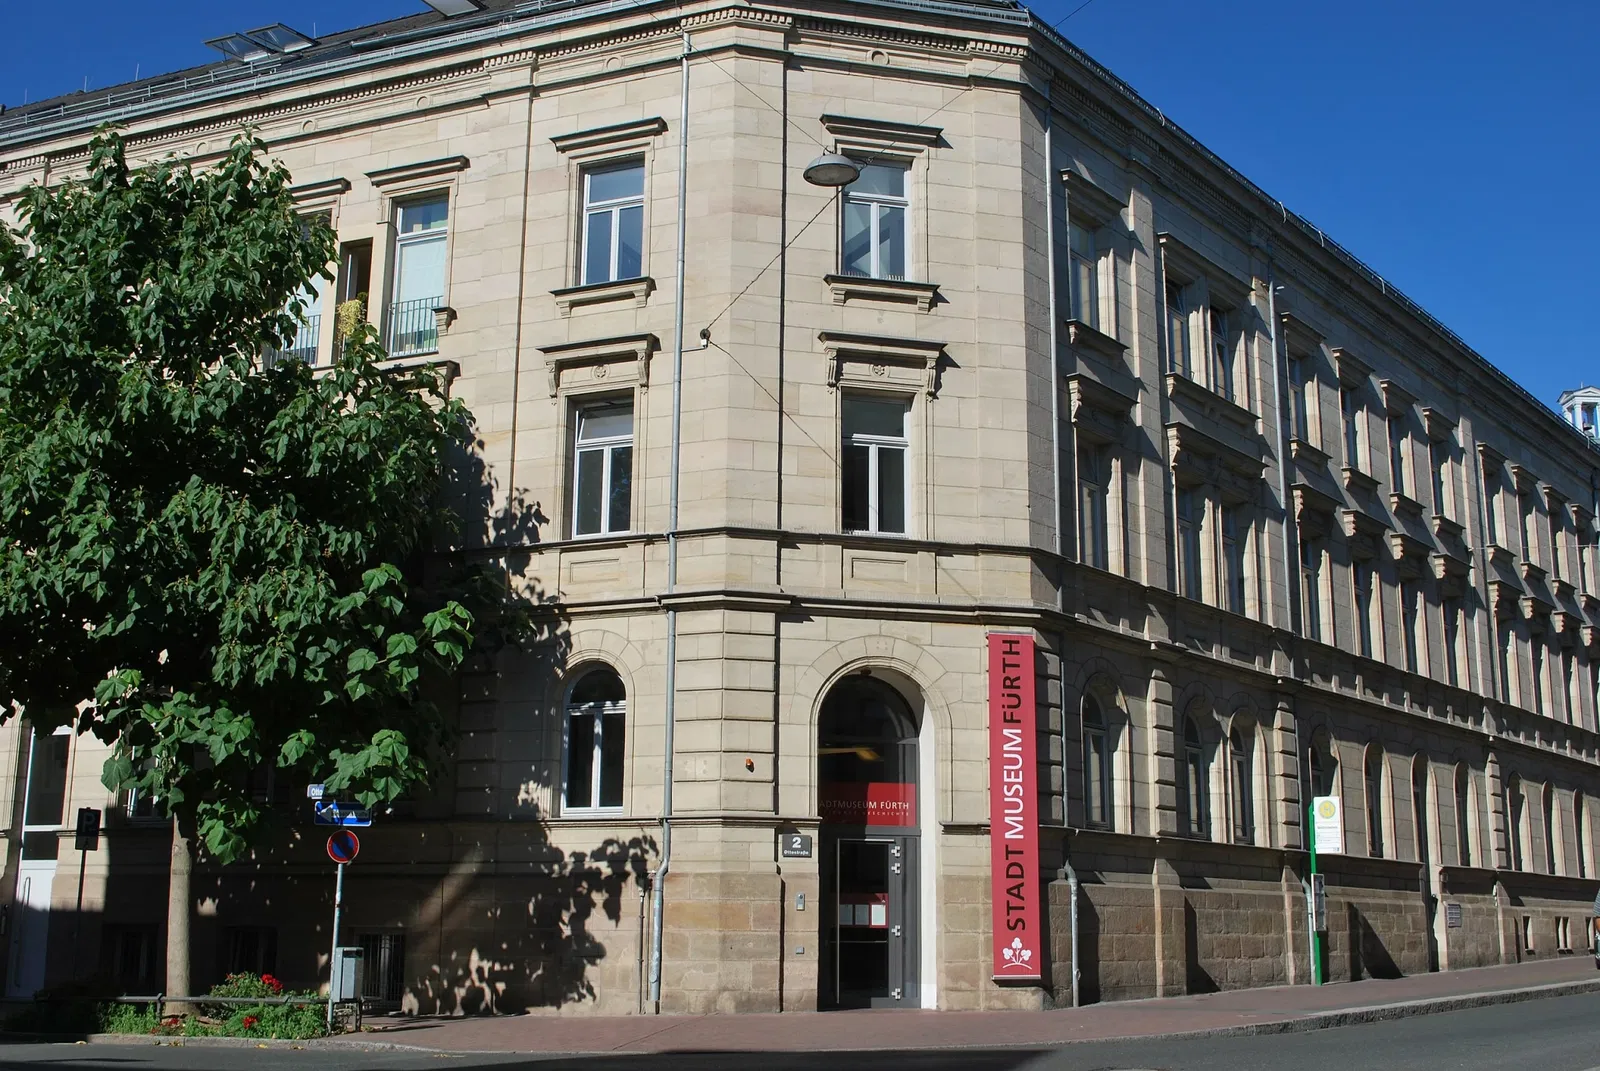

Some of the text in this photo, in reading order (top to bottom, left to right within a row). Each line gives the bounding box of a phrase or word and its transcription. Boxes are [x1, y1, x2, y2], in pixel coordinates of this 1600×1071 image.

[1001, 639, 1026, 931] STADT MUSEUM FÜRTH
[880, 800, 909, 810] FÜRTH
[82, 811, 96, 832] P
[792, 836, 802, 848] 2
